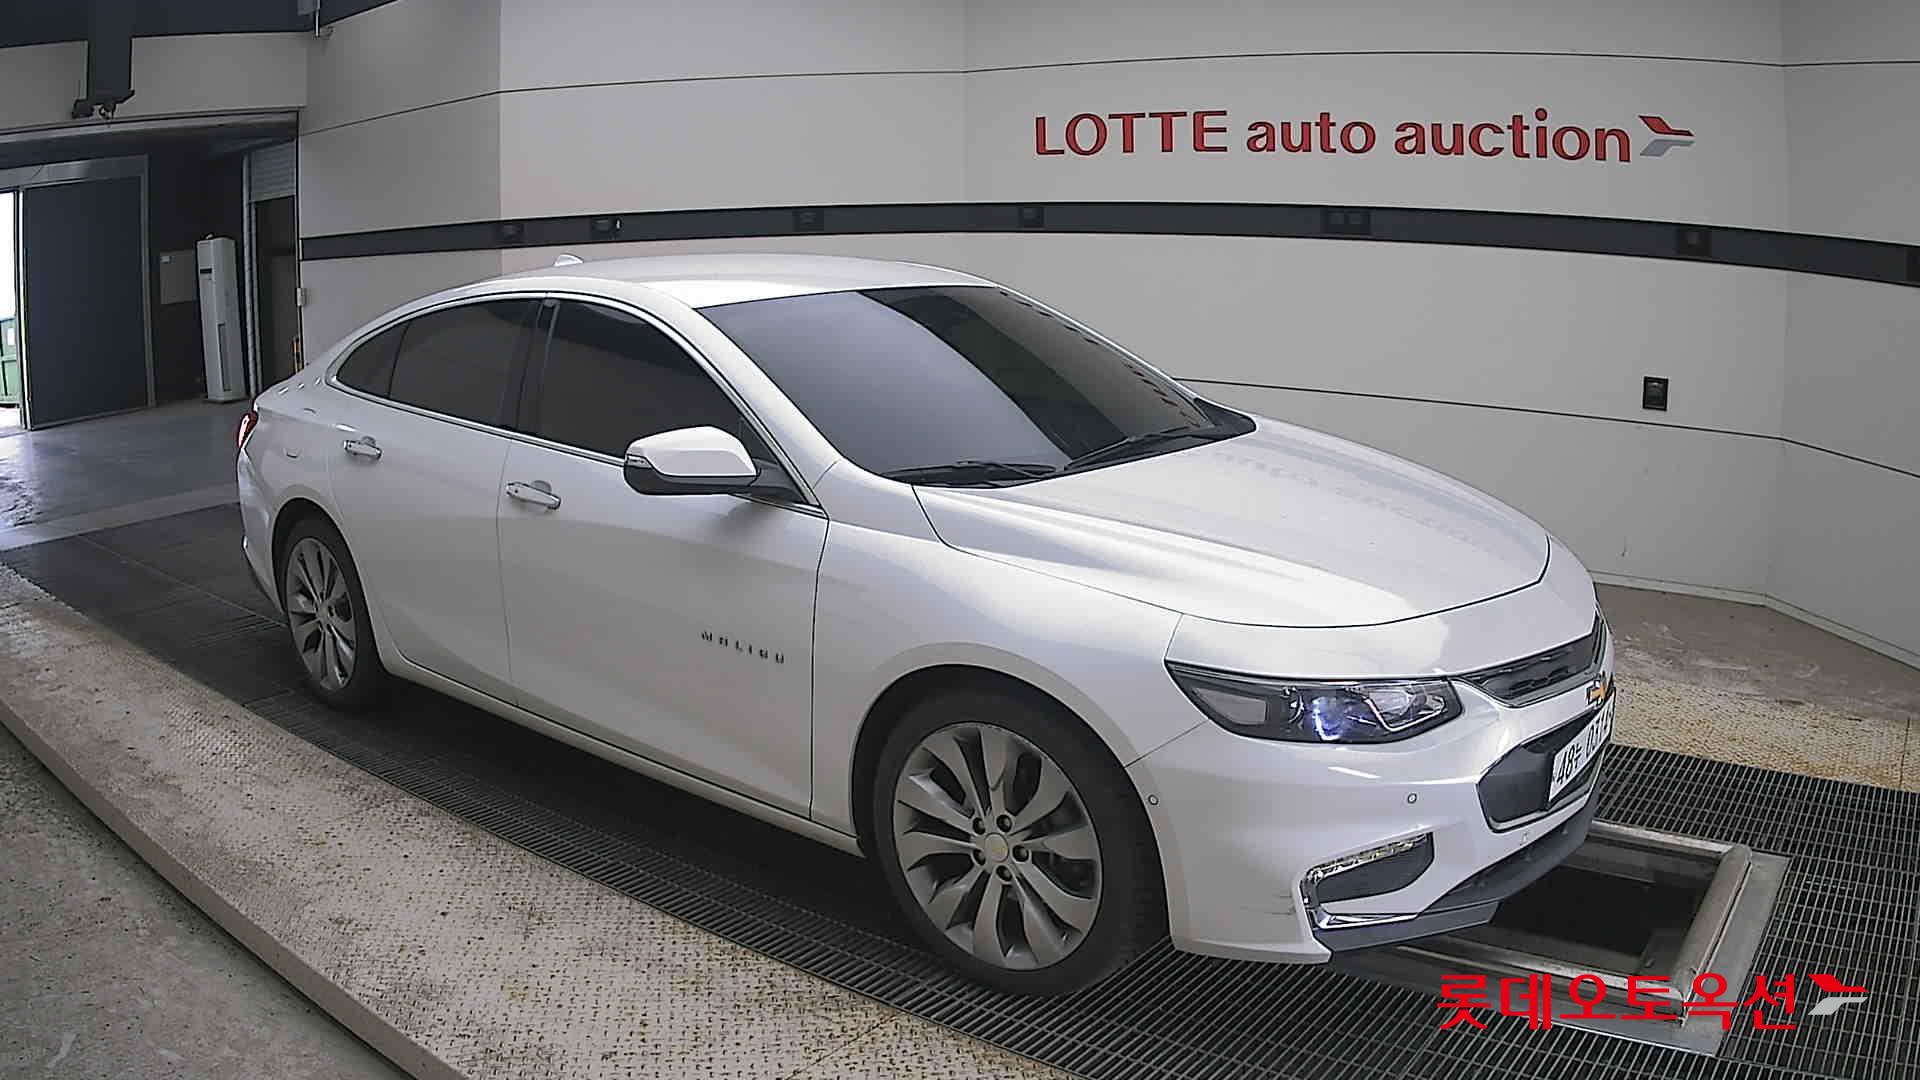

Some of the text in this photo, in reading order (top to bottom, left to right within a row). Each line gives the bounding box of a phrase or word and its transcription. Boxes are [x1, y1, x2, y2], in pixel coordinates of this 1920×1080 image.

[1035, 107, 1631, 163] LOTTE auto auction
[701, 630, 785, 665] MALIBU
